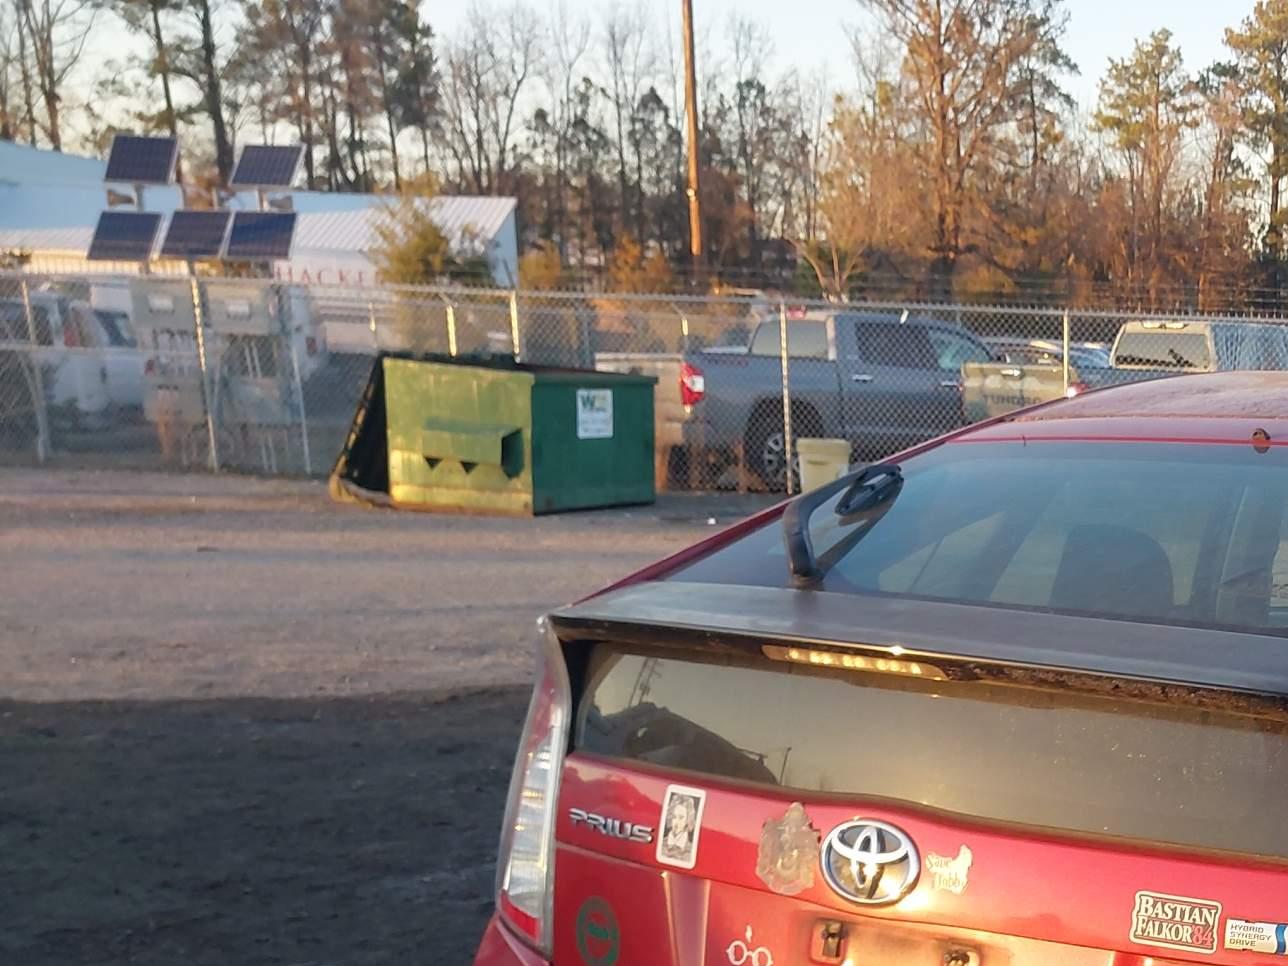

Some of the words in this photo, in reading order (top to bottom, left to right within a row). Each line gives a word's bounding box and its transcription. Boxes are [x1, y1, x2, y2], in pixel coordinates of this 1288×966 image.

[569, 807, 653, 843] PRIUS
[1138, 896, 1217, 927] BASTIAN
[1230, 924, 1264, 934] HYBRID
[1230, 931, 1272, 941] SYNERGY
[1229, 938, 1256, 947] DRIVE
